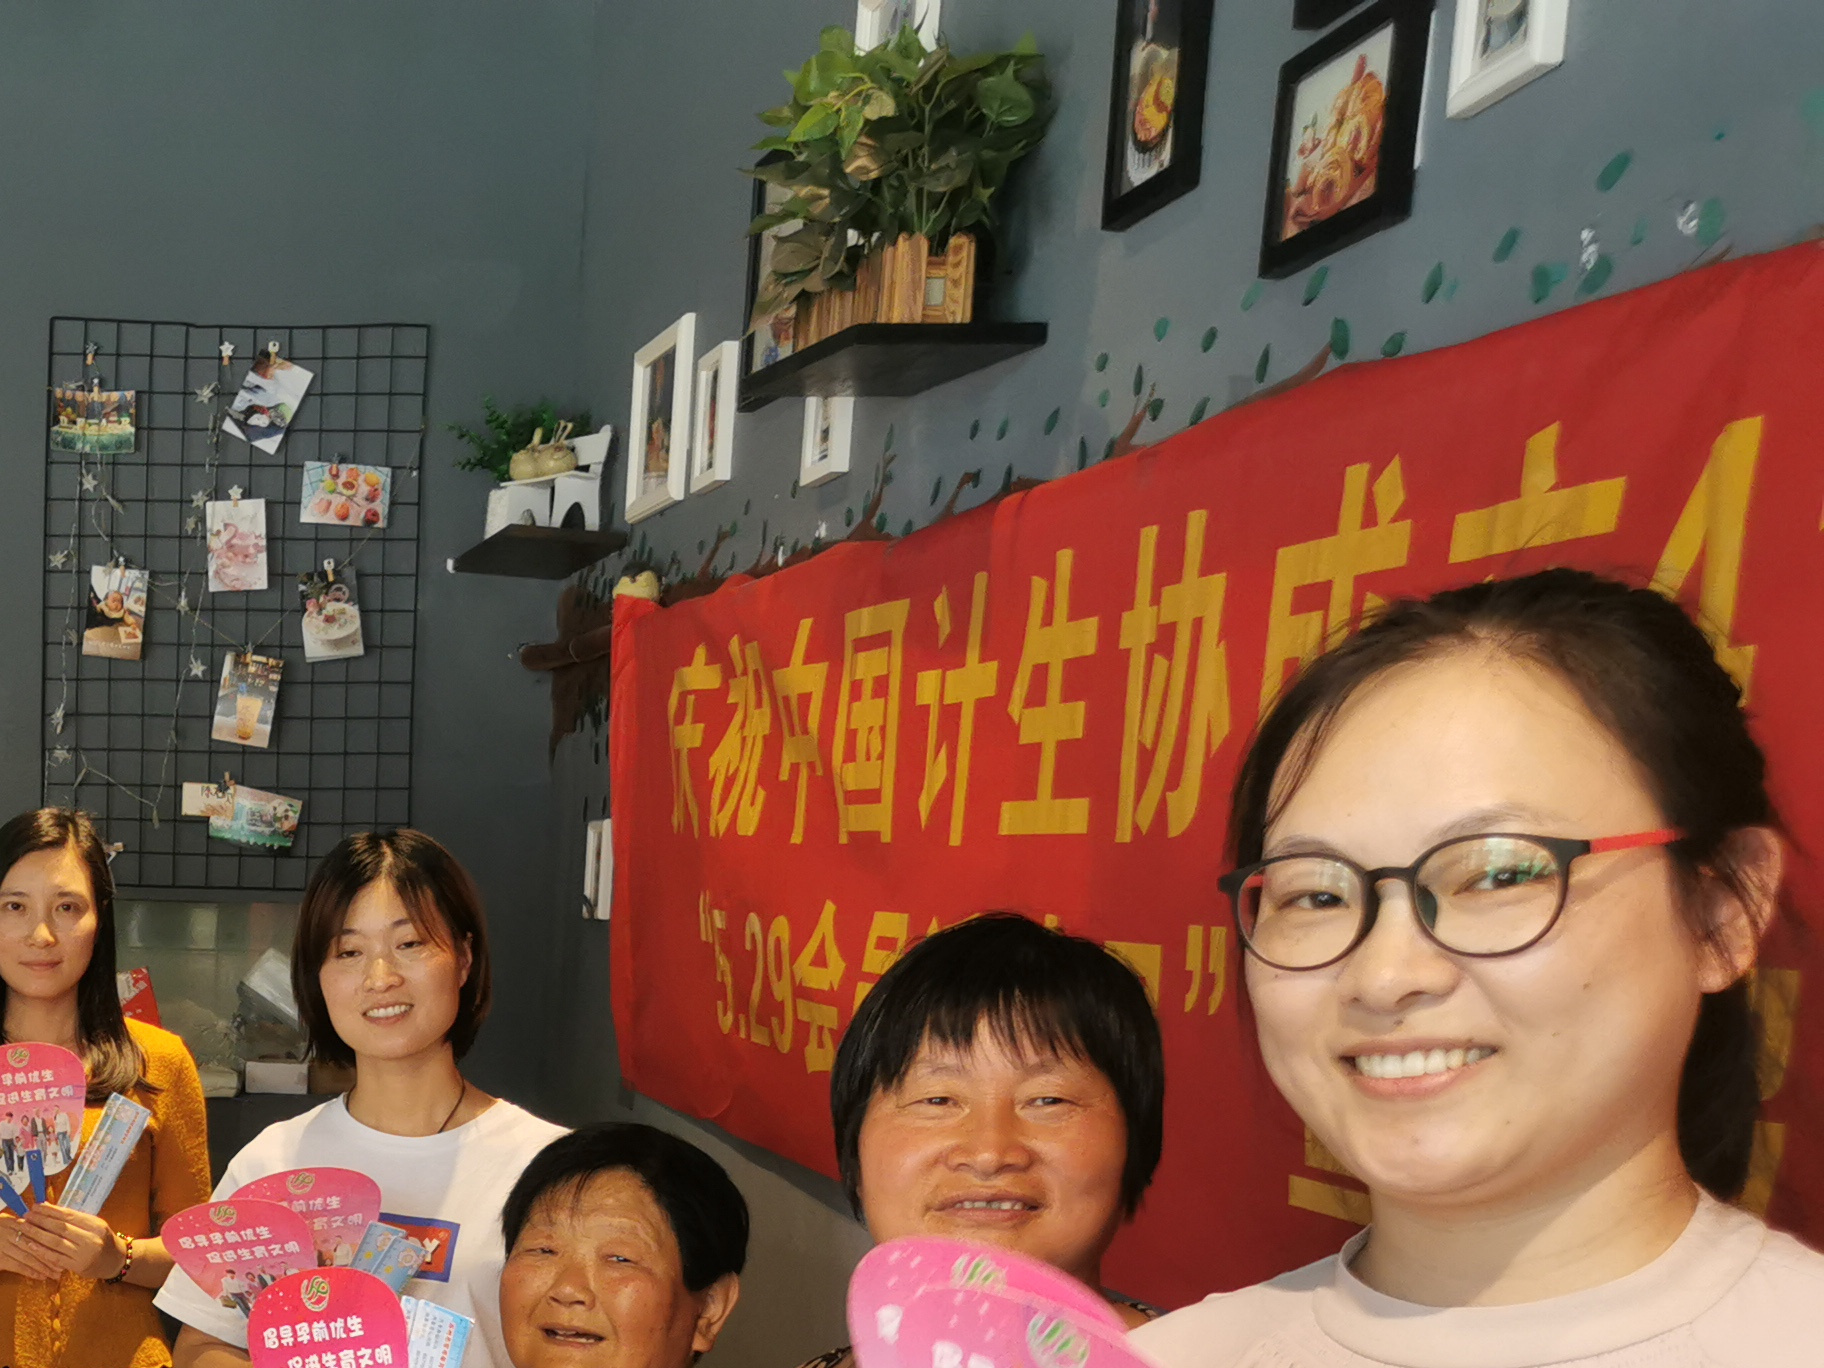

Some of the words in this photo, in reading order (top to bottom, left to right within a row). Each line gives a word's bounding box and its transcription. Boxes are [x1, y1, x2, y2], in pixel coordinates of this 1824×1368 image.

[178, 1226, 272, 1249] 倡导孕前优生
[205, 1239, 301, 1264] 促进生育文明
[263, 1315, 364, 1350] 倡导孕前优生
